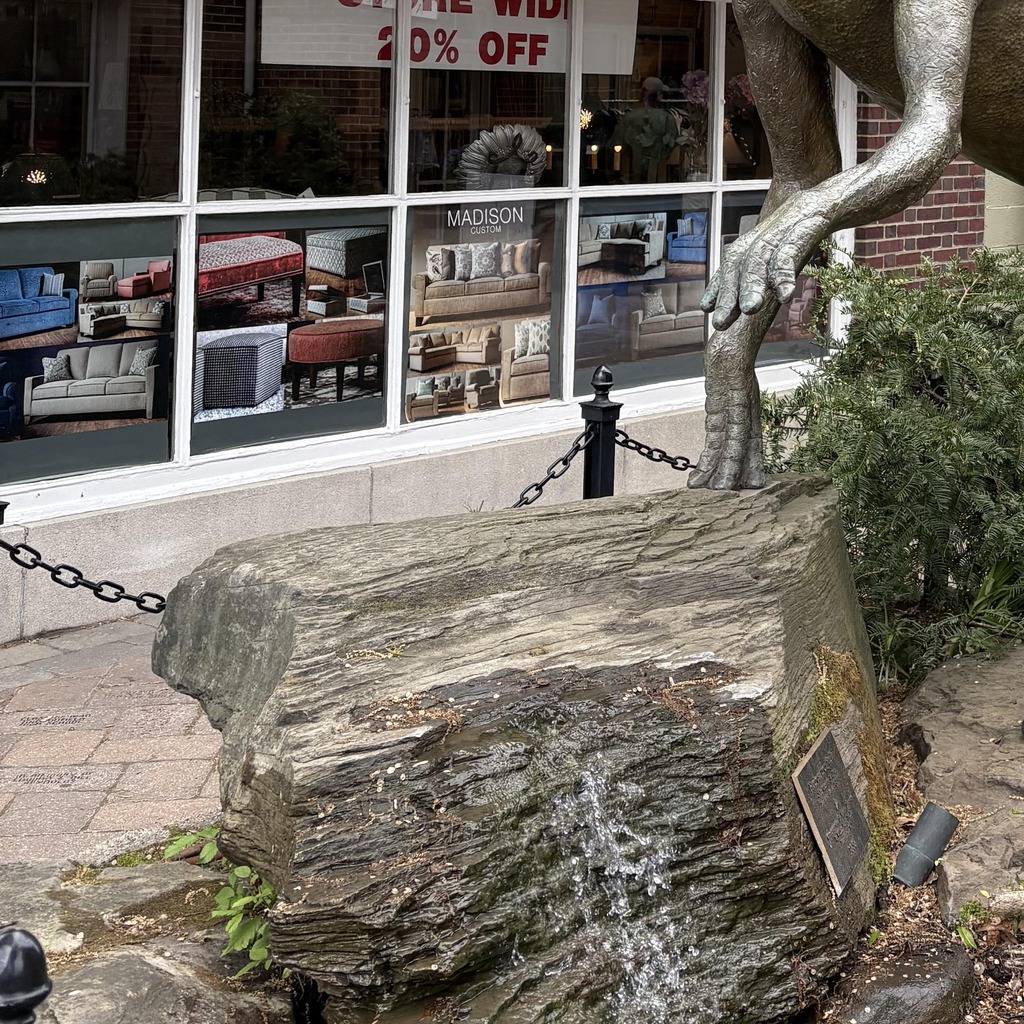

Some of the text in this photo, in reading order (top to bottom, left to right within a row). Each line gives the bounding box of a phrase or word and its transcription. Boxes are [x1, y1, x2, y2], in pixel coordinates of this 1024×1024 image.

[376, 26, 549, 66] 20% OFF
[447, 206, 523, 227] MADISON
[470, 225, 502, 235] CUSTOM
